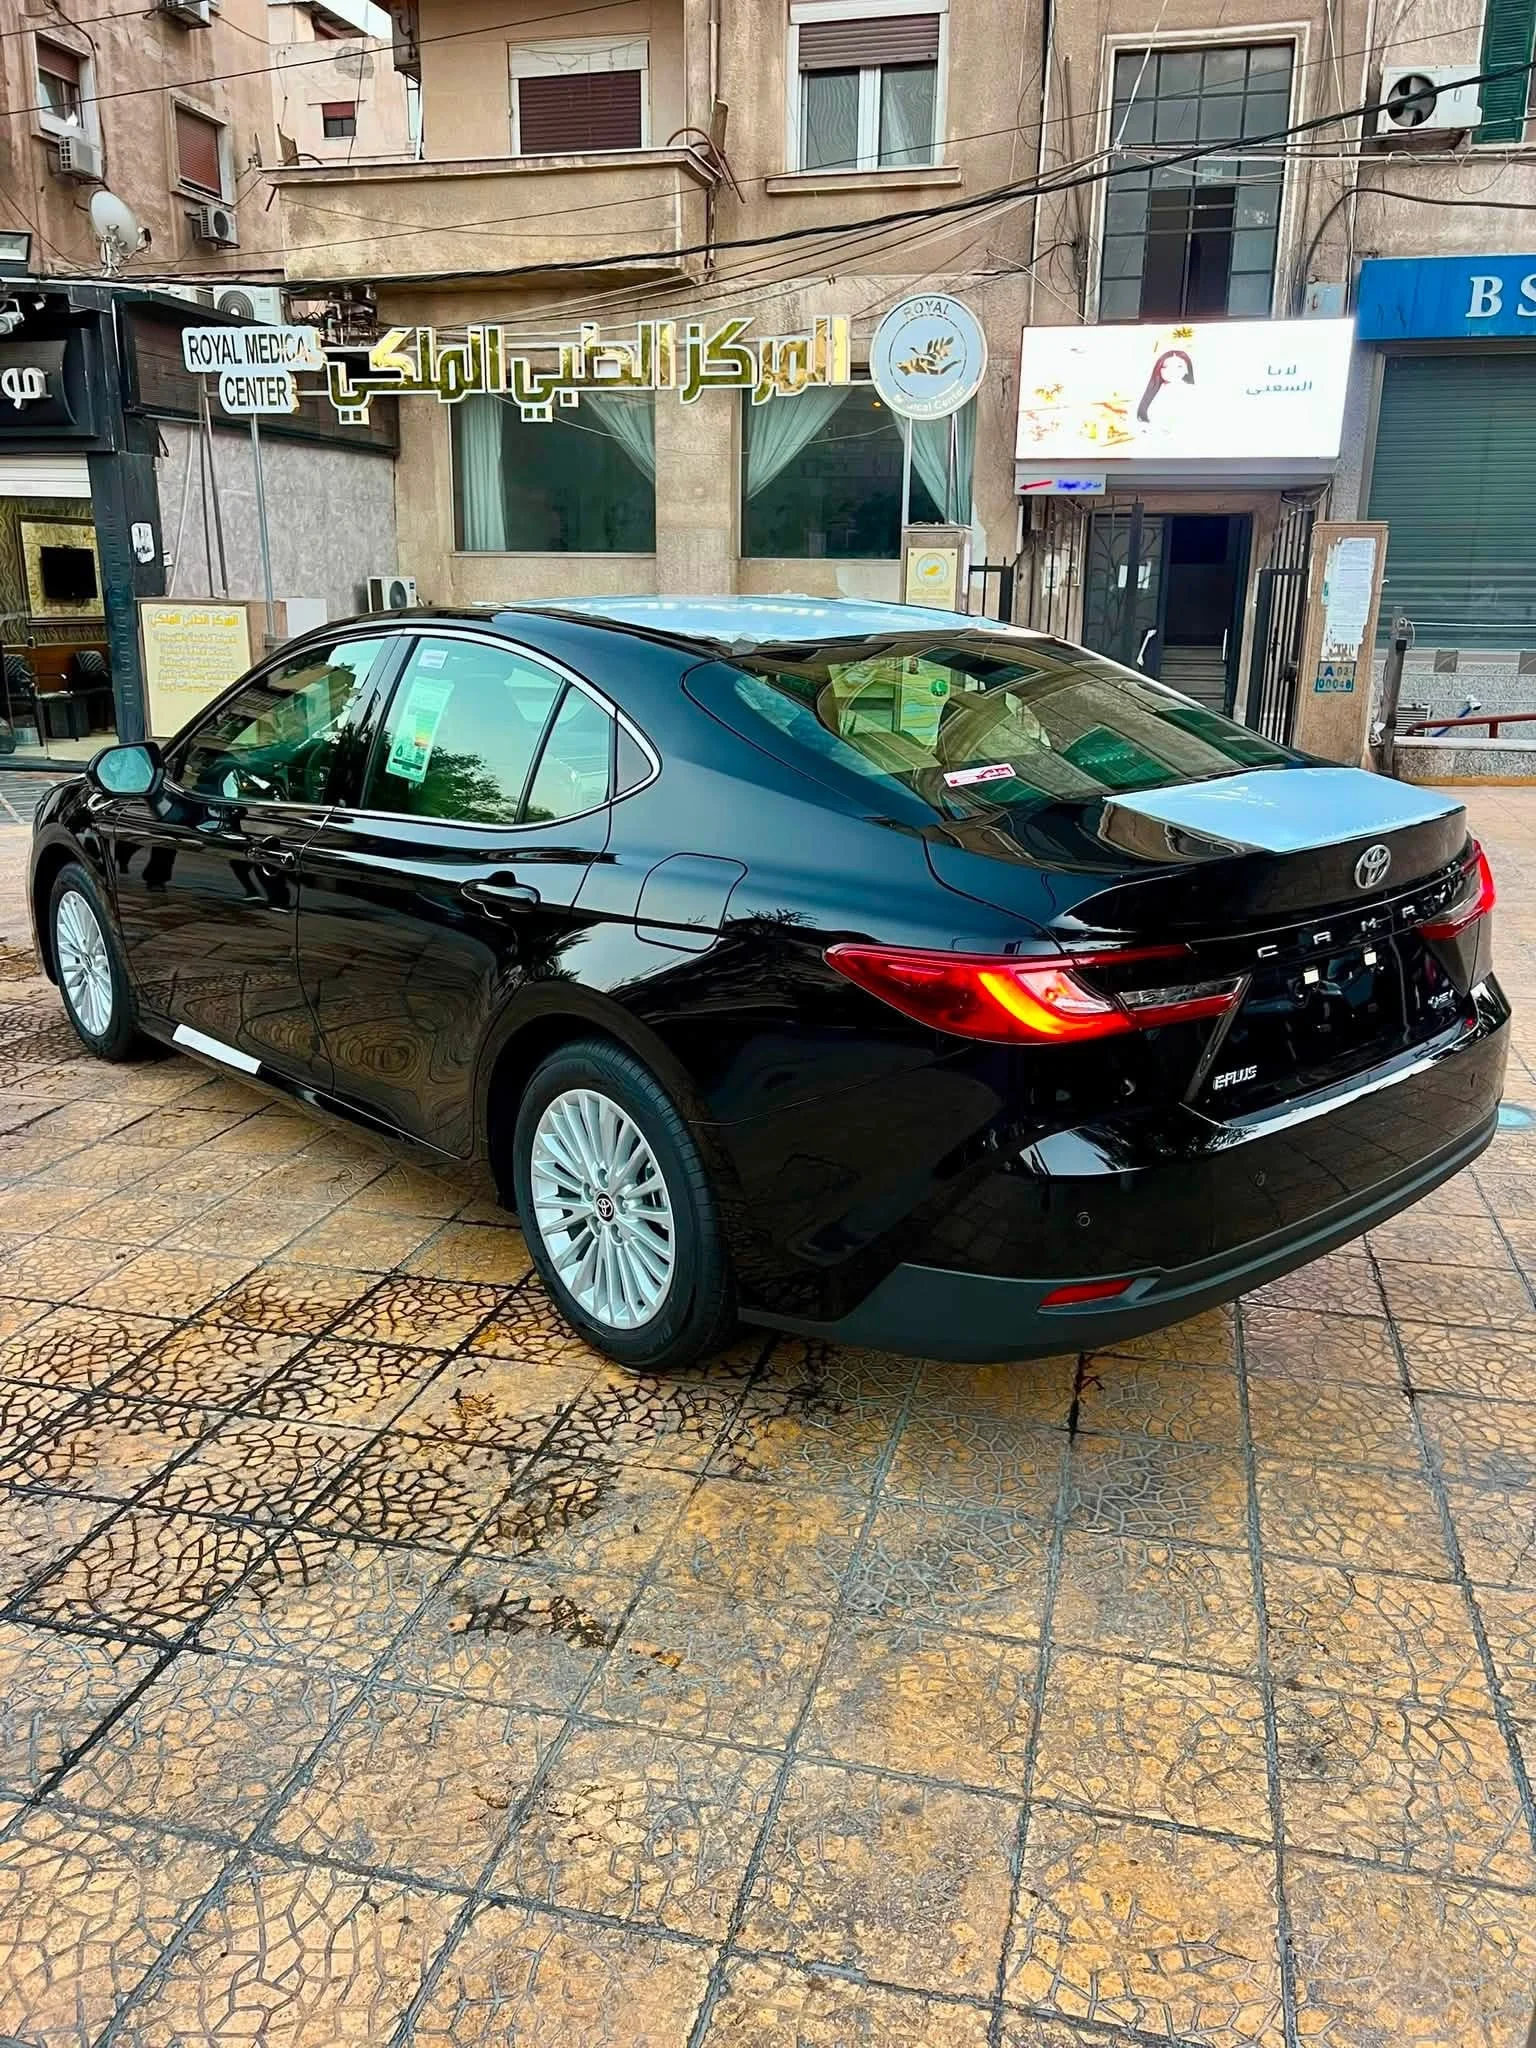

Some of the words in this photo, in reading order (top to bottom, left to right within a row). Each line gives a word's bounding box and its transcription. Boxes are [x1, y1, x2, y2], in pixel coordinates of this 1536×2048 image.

[903, 300, 950, 317] ROYAL
[188, 334, 242, 365] ROYAL
[245, 333, 316, 364] MEDICA
[325, 325, 504, 425] الملكي
[511, 321, 676, 422] الطبي
[680, 315, 851, 406] المركز
[225, 376, 289, 406] CENTER
[1324, 665, 1334, 677] A
[1257, 884, 1448, 959] CAMRY
